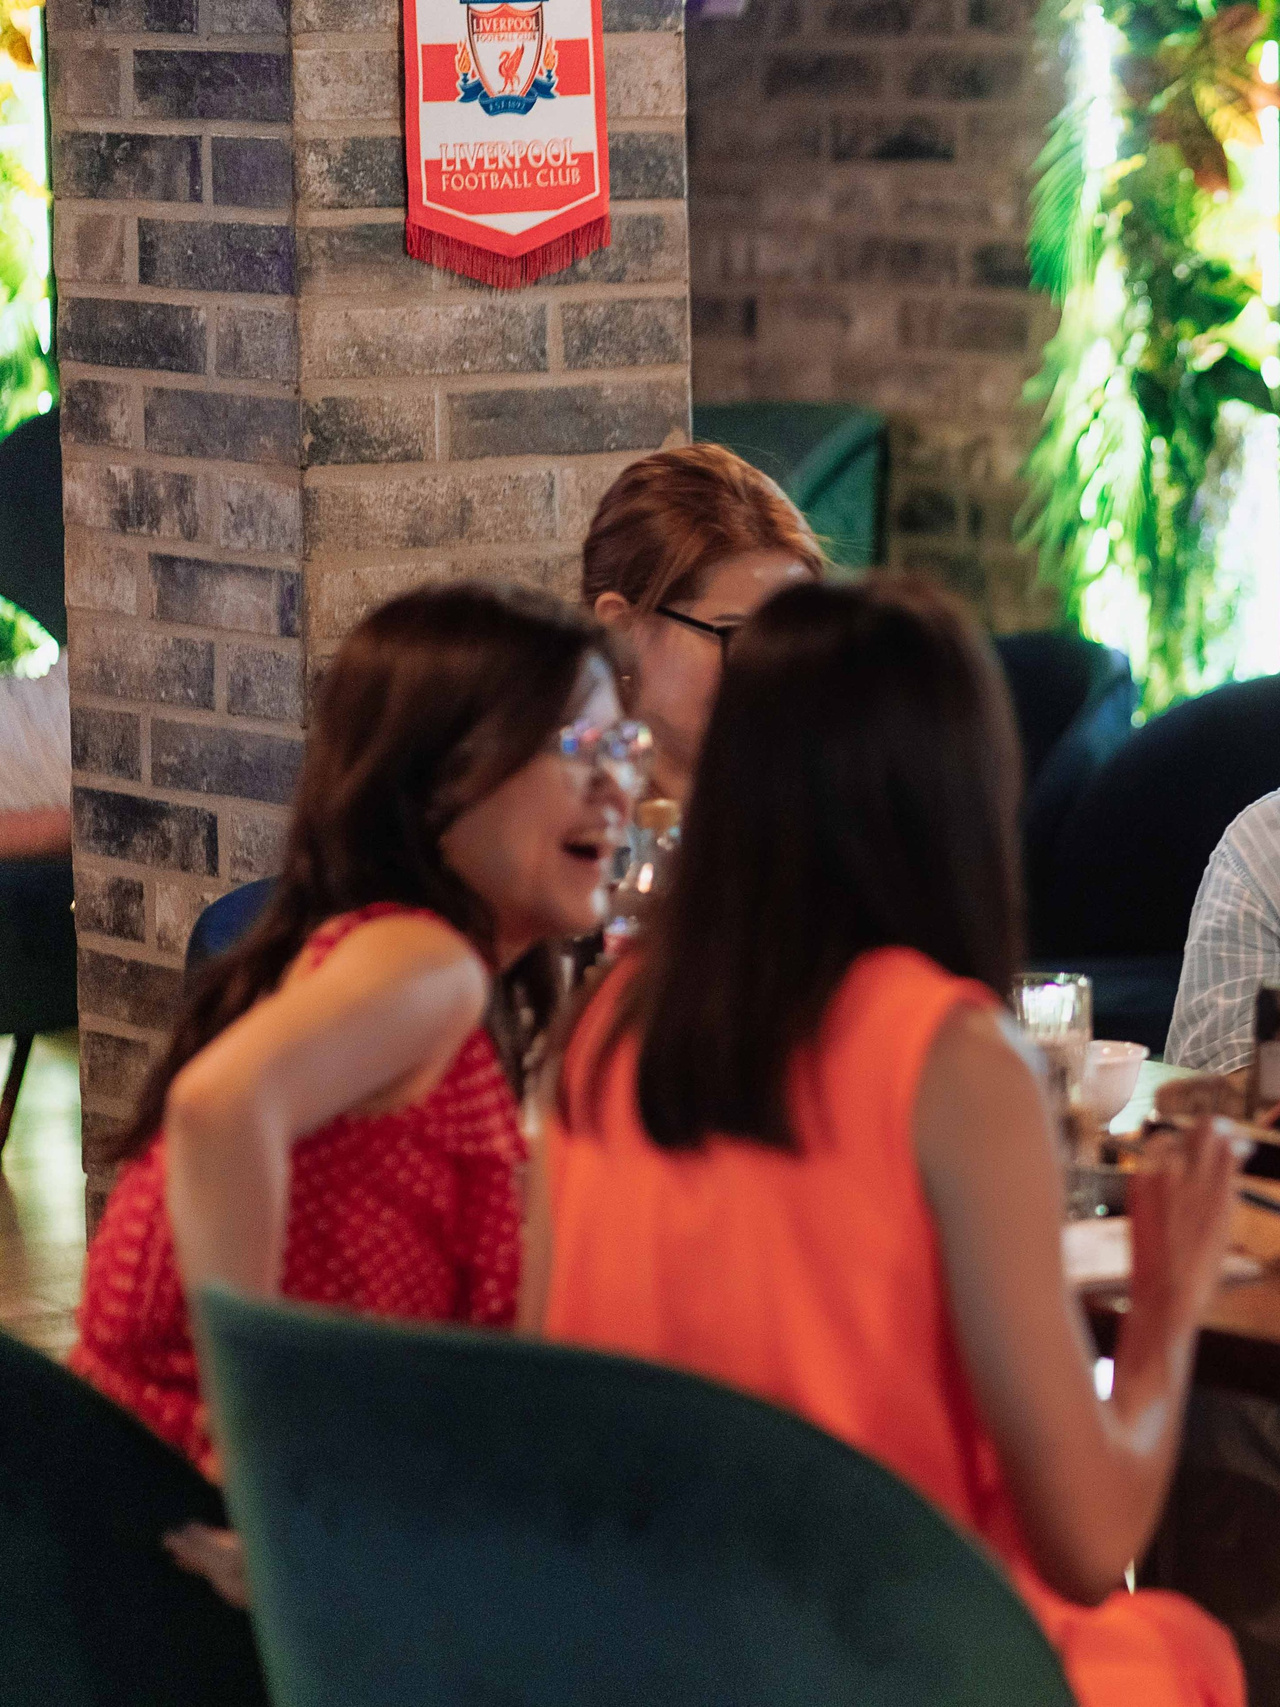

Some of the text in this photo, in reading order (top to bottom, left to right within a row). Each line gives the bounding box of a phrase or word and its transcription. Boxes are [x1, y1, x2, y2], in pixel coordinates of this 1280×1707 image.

[473, 16, 539, 33] LIVERPOOL
[439, 137, 579, 171] LIVERPOOL
[441, 167, 581, 192] FOOTBALL CLUB
